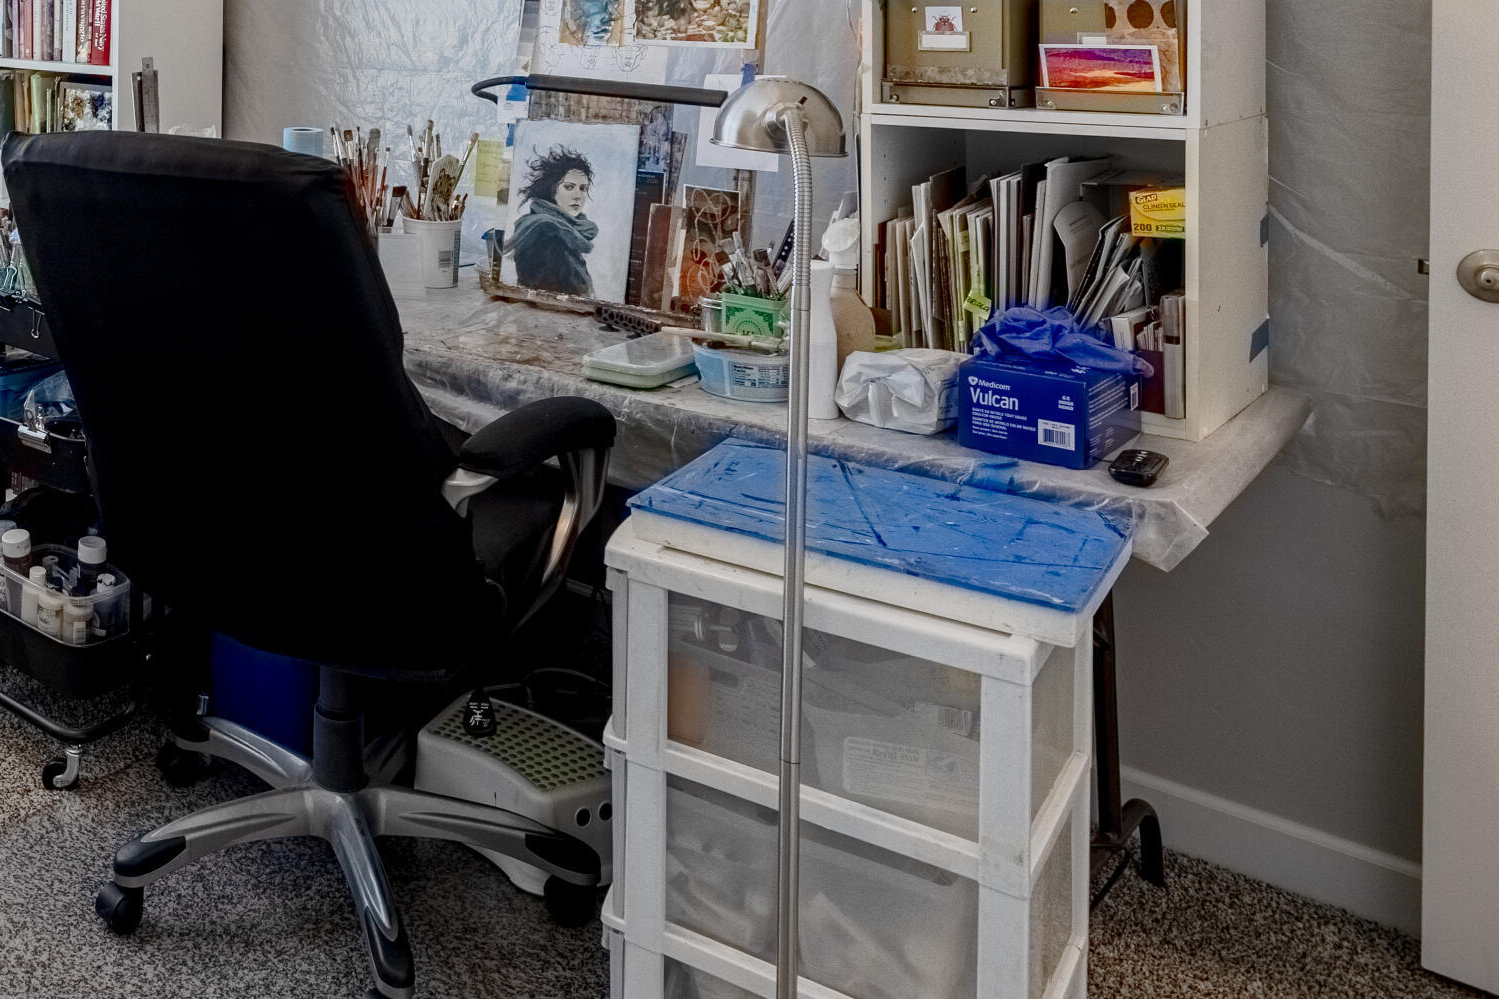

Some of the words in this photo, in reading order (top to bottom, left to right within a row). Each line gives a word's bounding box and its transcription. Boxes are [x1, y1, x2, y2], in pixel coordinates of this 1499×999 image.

[100, 13, 108, 33] States
[97, 33, 107, 52] Navy
[1136, 194, 1157, 204] GLAD
[1169, 201, 1186, 209] SEAL
[1133, 223, 1152, 232] 200
[978, 379, 1011, 391] Medicom
[970, 386, 1019, 410] Vulcan
